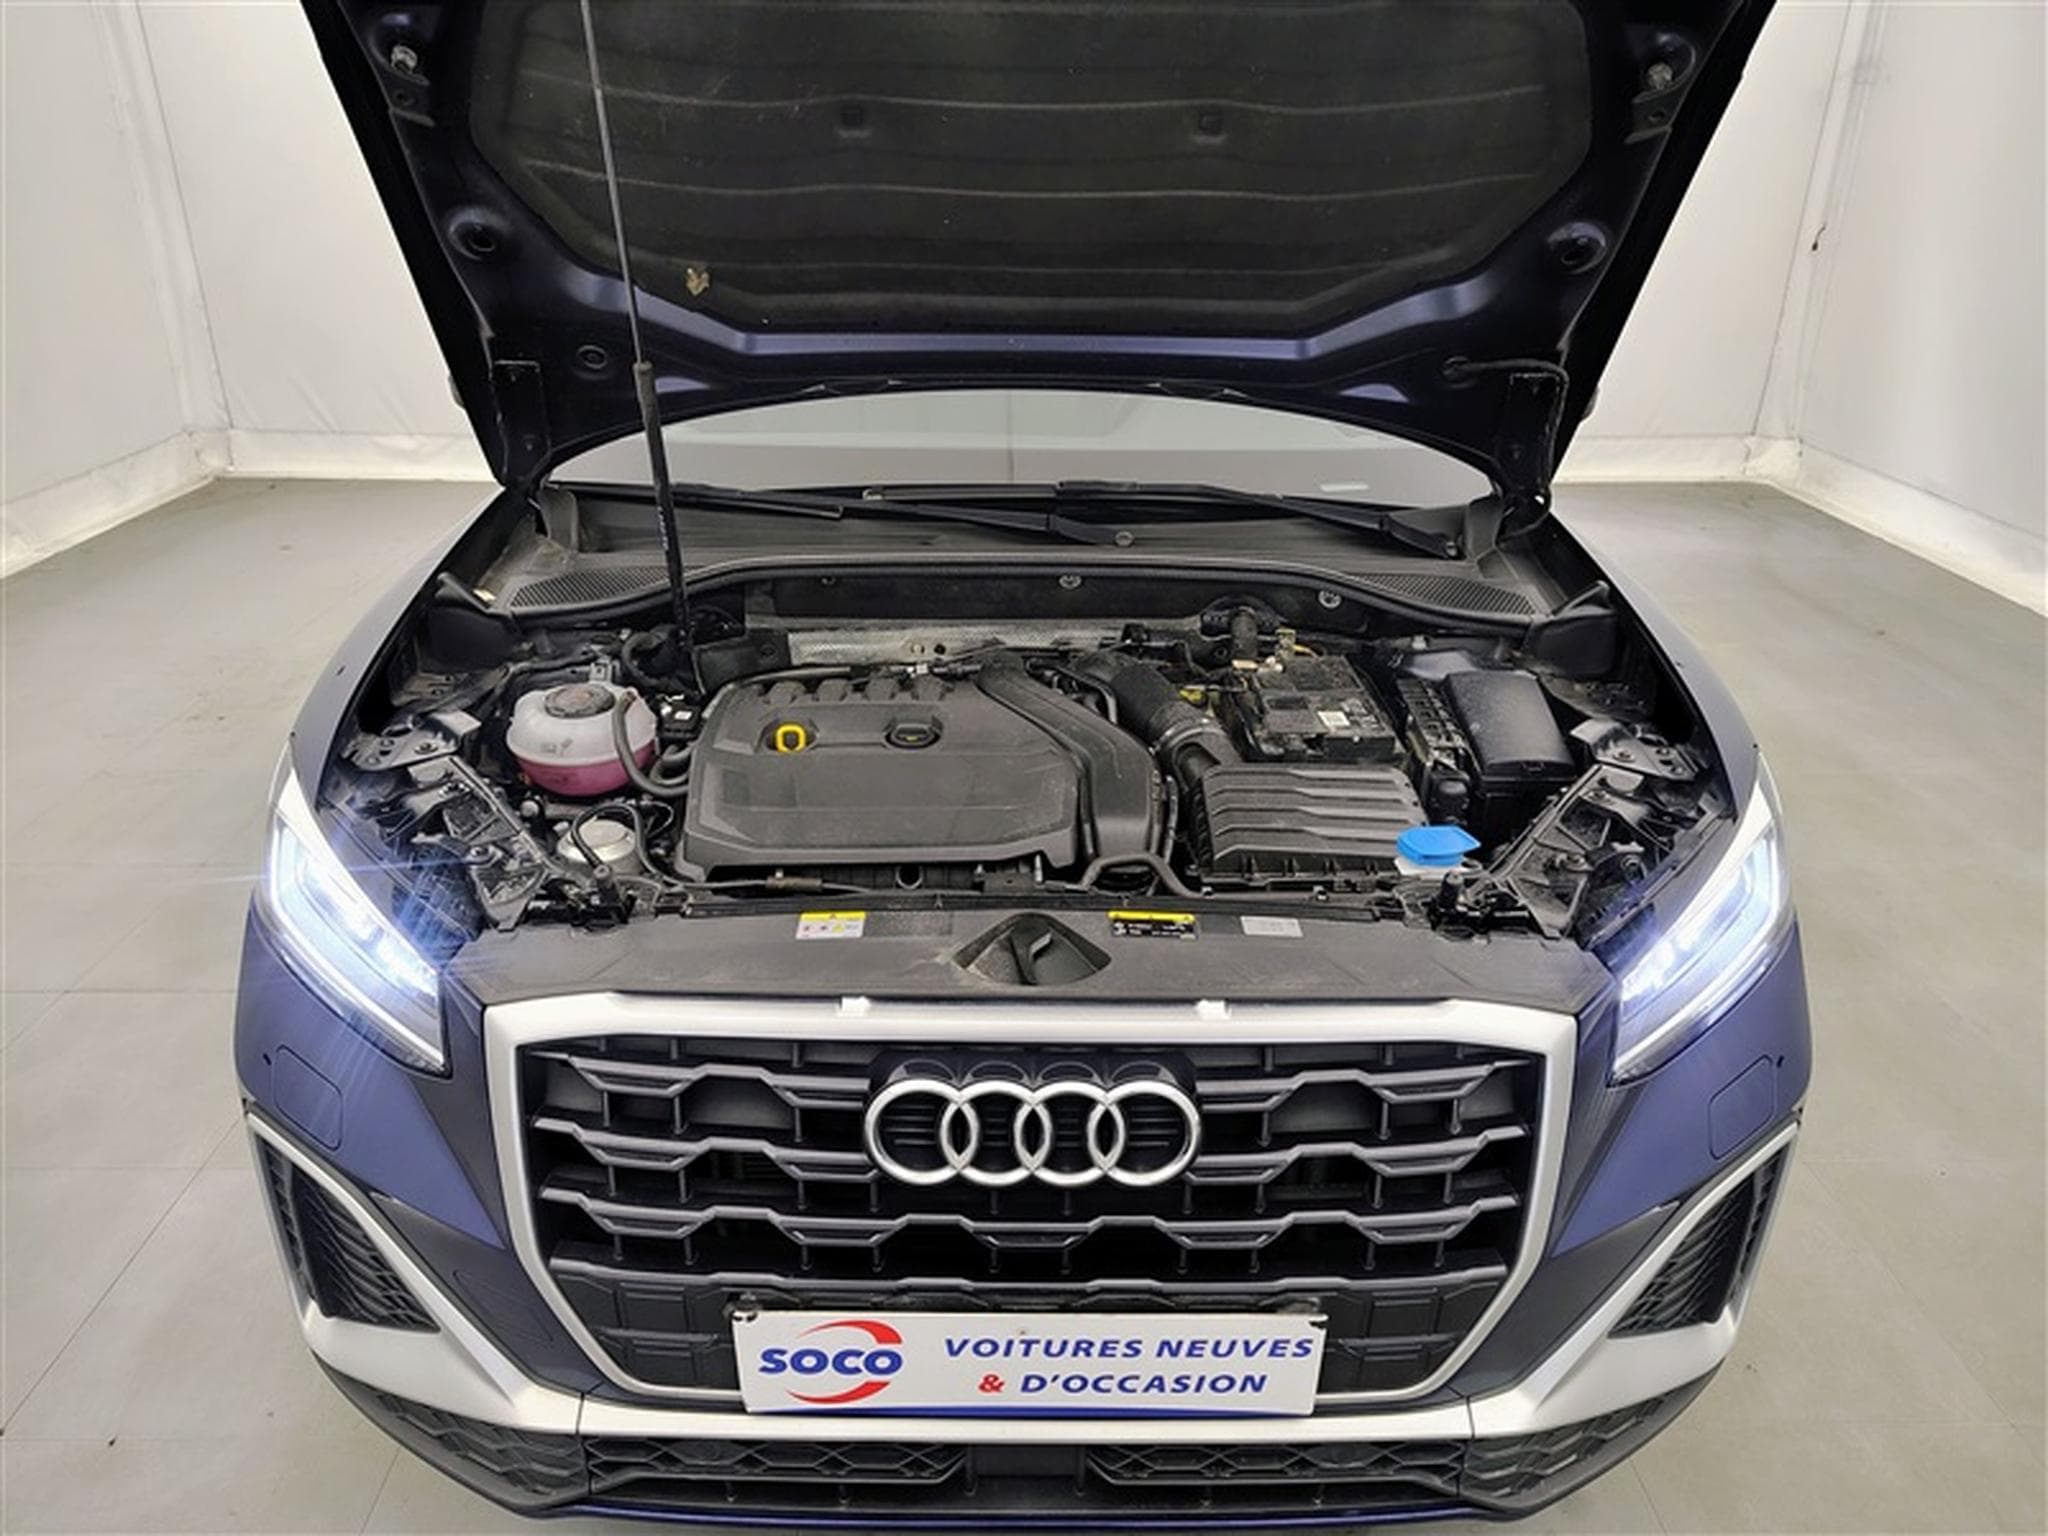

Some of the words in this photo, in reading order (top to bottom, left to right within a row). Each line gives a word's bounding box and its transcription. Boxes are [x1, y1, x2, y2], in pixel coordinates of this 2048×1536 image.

[945, 1338, 1143, 1358] VOITURES
[1156, 1338, 1313, 1359] NEUVES
[758, 1348, 904, 1377] SOCO
[978, 1374, 1004, 1394] &
[1020, 1374, 1268, 1394] D'OCCASION
